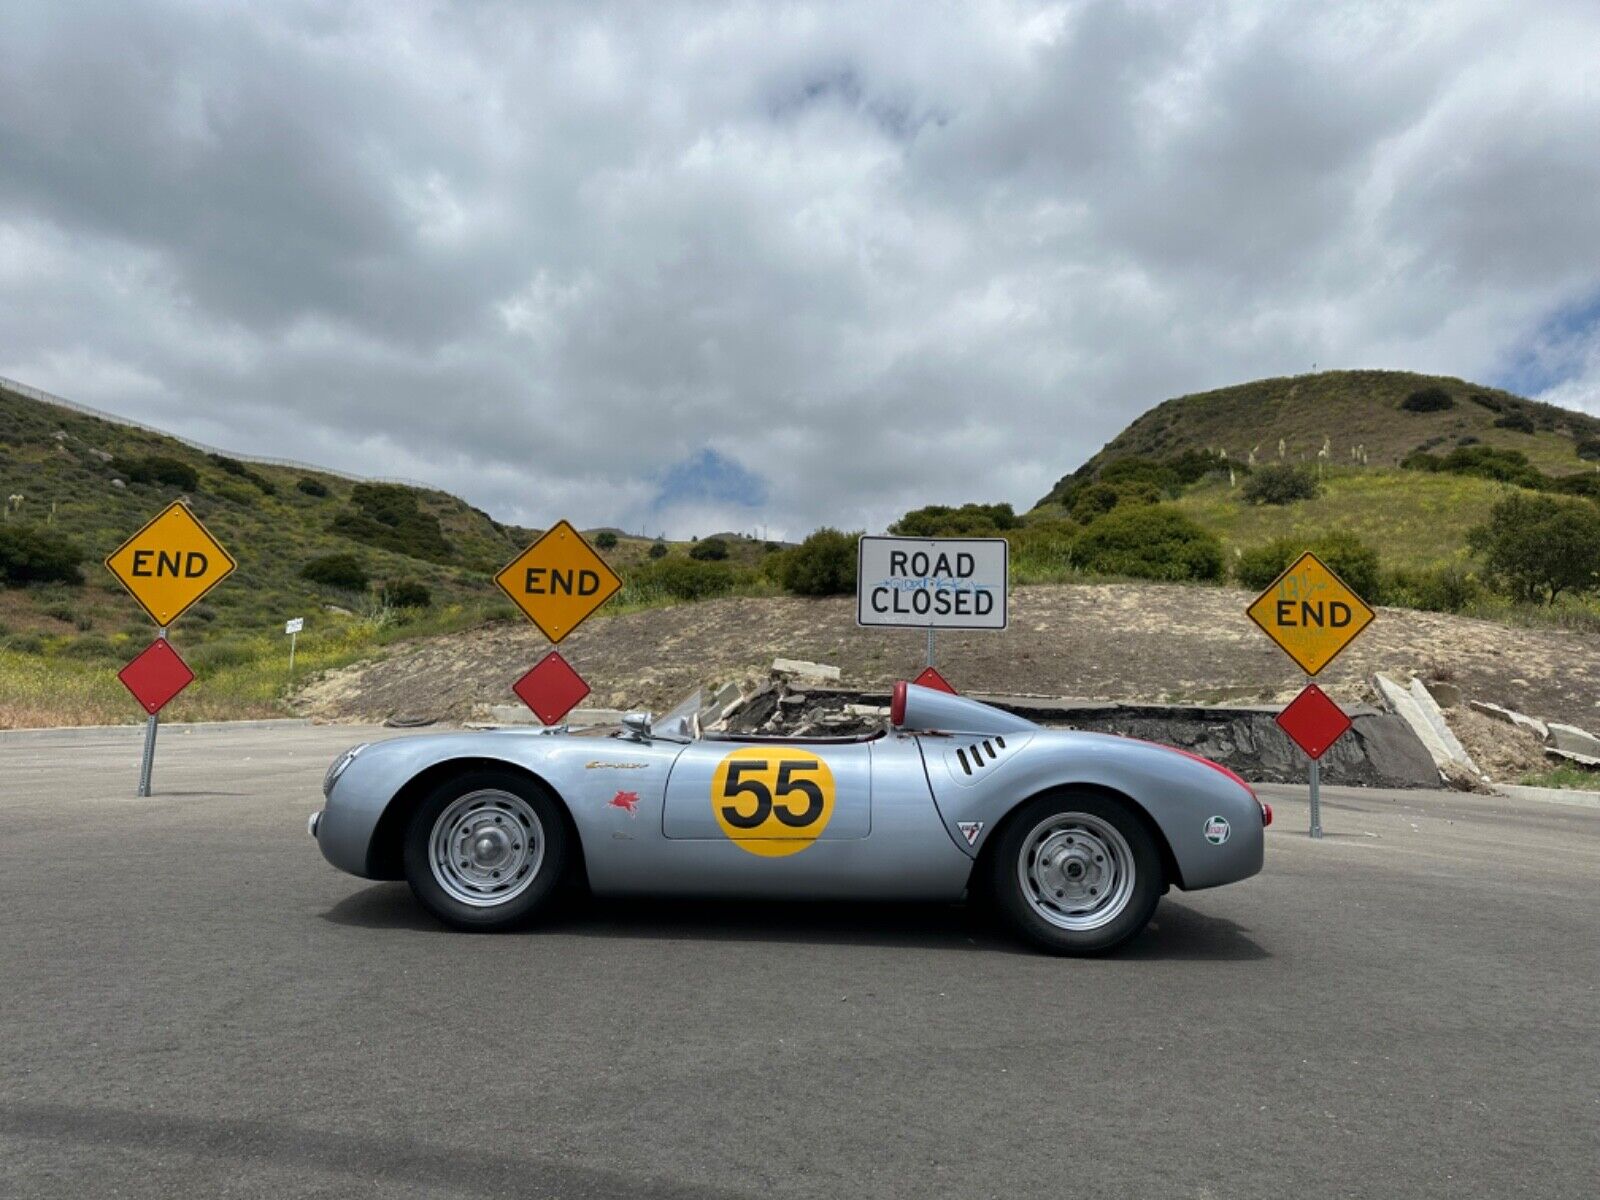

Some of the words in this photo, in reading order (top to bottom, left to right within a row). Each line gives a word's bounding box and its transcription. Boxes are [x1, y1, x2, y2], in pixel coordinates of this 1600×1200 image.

[132, 550, 209, 578] END
[889, 550, 975, 578] ROAD
[525, 567, 600, 596] END
[871, 587, 993, 615] CLOSED
[1276, 600, 1352, 628] END
[721, 760, 825, 829] 55
